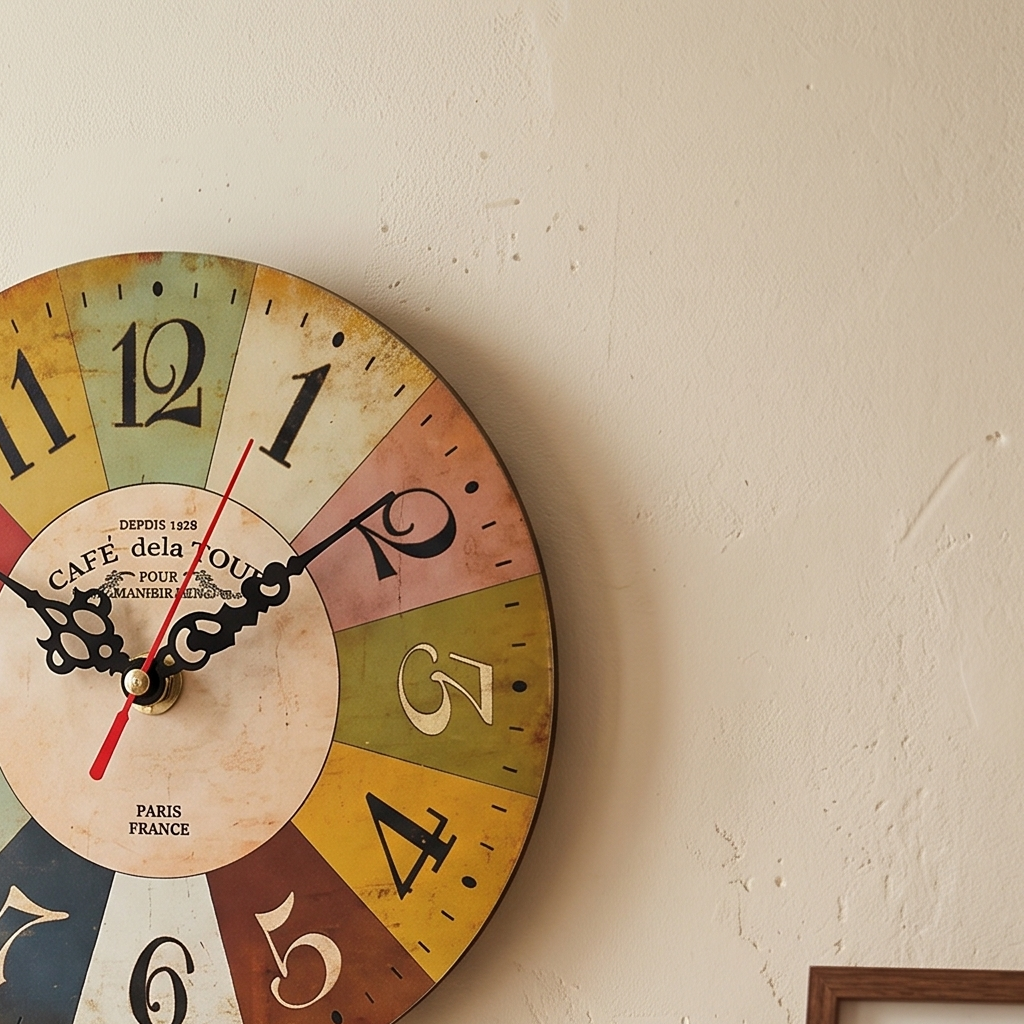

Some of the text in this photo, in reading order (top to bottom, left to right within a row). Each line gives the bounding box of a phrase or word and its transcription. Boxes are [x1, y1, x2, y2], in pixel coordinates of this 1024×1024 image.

[111, 318, 206, 428] 12
[258, 363, 332, 469] 1
[119, 519, 198, 531] DEPDIS 1928
[131, 536, 184, 558] dela
[349, 487, 457, 582] 2
[139, 571, 178, 583] POUR
[397, 642, 493, 736] 3
[128, 821, 190, 836] FRANCE
[136, 804, 182, 818] PARIS
[365, 792, 457, 900] 4
[254, 891, 343, 1009] 5
